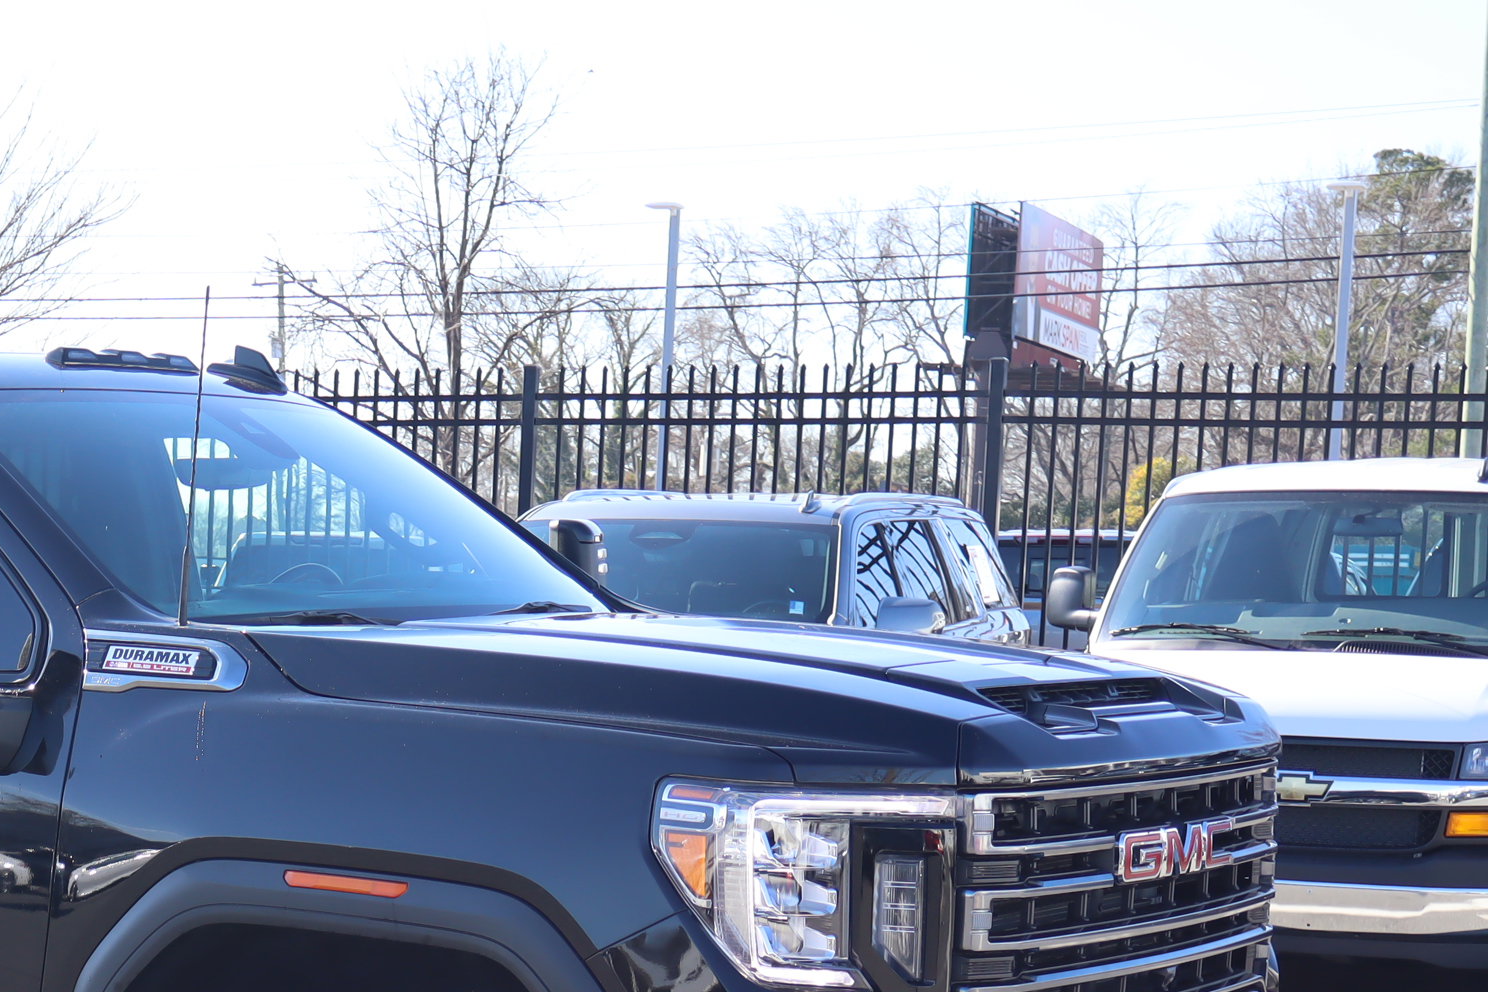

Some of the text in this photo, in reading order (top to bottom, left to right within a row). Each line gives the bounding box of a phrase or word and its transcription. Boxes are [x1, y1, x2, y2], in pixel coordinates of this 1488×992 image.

[1045, 248, 1098, 300] CASH OFFER
[1043, 316, 1062, 347] MARK
[1061, 323, 1080, 352] SPAIN
[112, 648, 192, 665] DURAMAX
[153, 664, 188, 673] LITER
[1118, 819, 1233, 882] GMC
